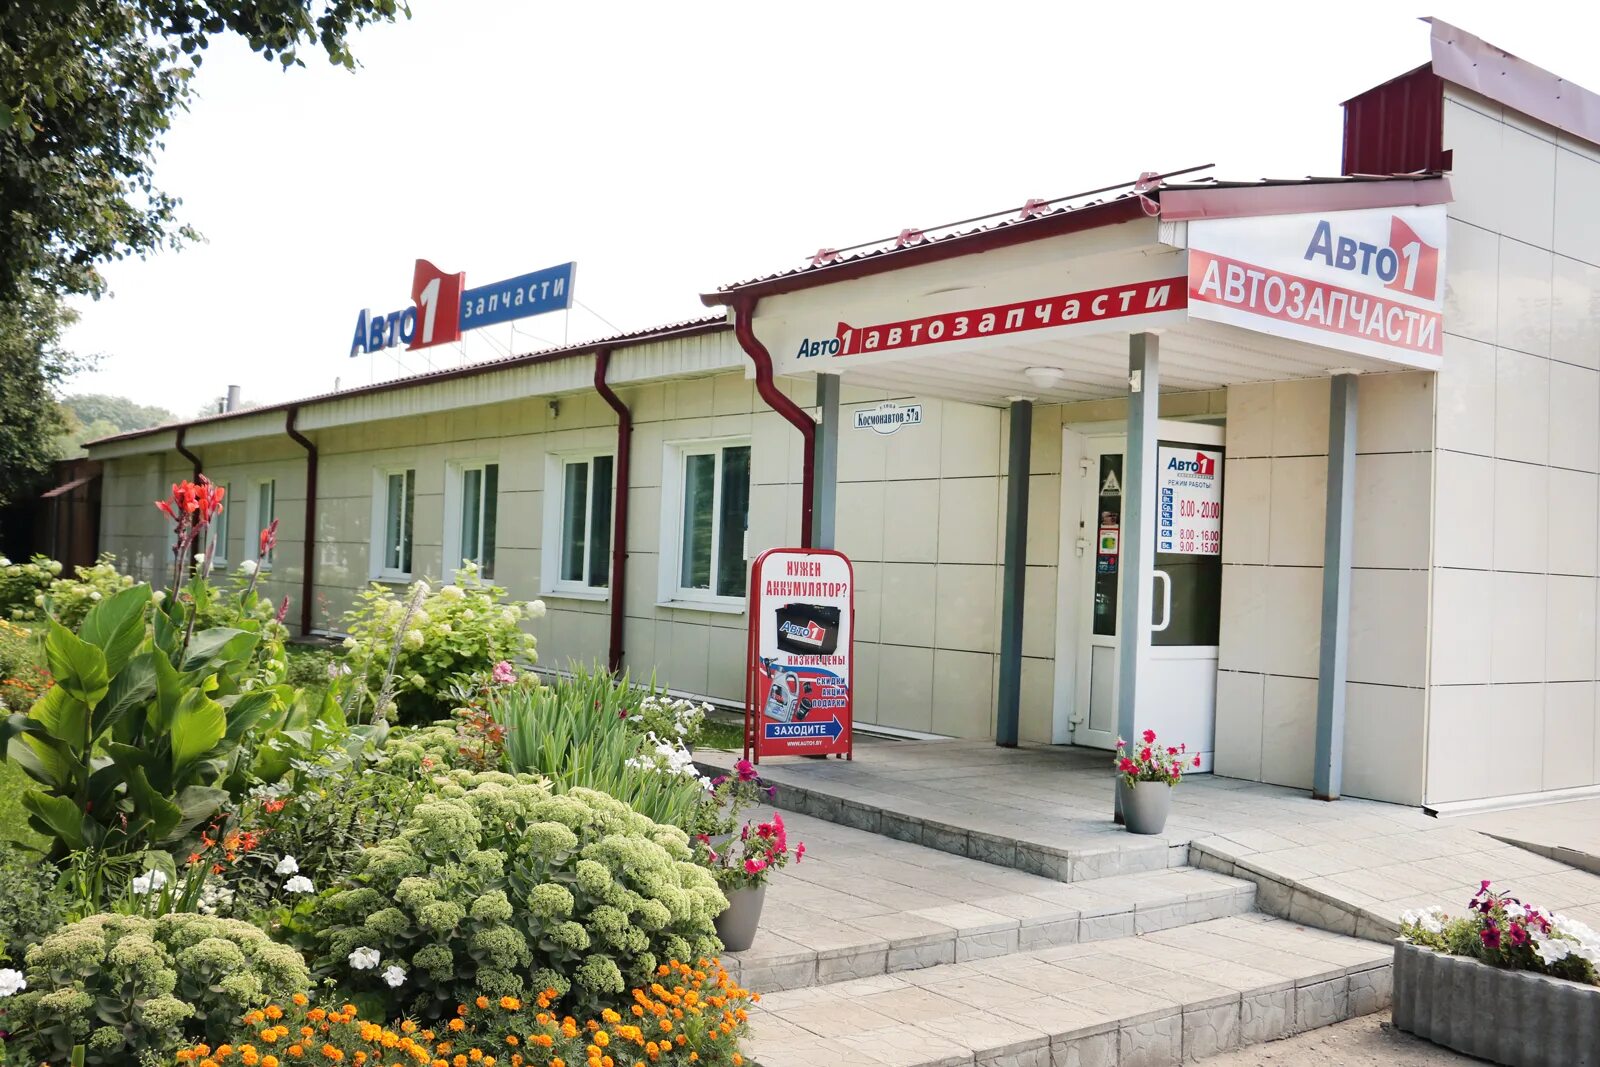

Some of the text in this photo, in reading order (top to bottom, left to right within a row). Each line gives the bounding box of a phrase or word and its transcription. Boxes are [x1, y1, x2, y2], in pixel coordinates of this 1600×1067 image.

[464, 277, 565, 318] запчасти
[1197, 259, 1436, 350] АВТОЗАПЧАСТИ
[864, 284, 1171, 349] автозапчасти
[858, 413, 904, 426] Космонавтов
[1180, 500, 1195, 517] 8.00
[1201, 502, 1220, 519] 20.00
[1180, 529, 1195, 540] 8.00
[1201, 531, 1219, 541] 16.00
[1180, 541, 1194, 552] 9.00
[1201, 542, 1219, 553] 15.00
[787, 561, 821, 577] НУЖЕН
[766, 580, 848, 598] АККУМУЛЯТОР?
[787, 655, 846, 667] НИЗКИЕ ЦЕНЫ
[816, 677, 846, 687] СКИДКИ
[822, 688, 846, 697] АКЦИИ
[812, 698, 846, 709] ПОДАРКИ
[774, 724, 827, 736] ЗАХОДИТЕ
